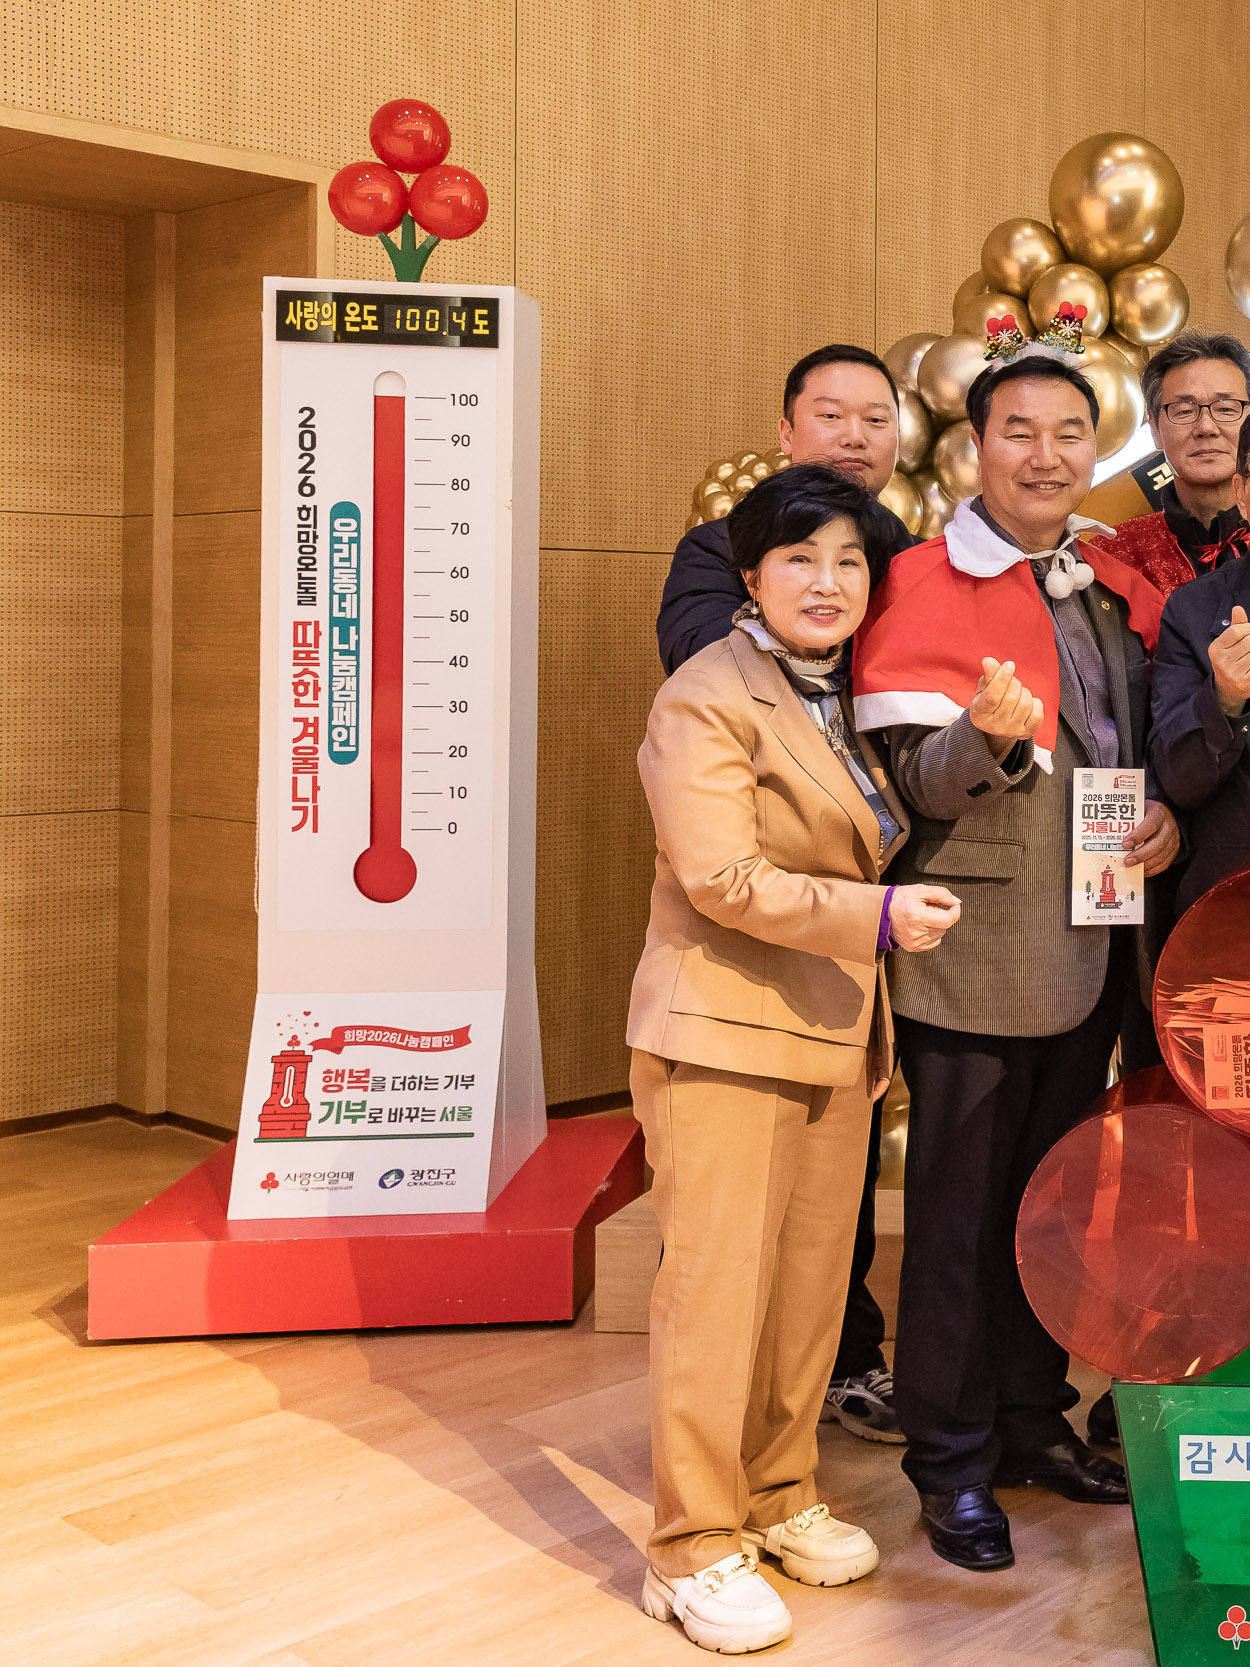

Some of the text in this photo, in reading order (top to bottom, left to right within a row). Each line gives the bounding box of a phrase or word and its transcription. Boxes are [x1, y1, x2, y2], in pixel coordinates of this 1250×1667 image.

[285, 300, 337, 332] 사랑의
[343, 301, 379, 332] 온도
[451, 394, 479, 407] 100
[451, 434, 471, 447] 90
[451, 478, 470, 491] 80
[450, 523, 470, 535] 70
[450, 566, 470, 579] 60
[291, 406, 322, 833] 2026 희망온돌 따뜻한 겨울나기
[449, 610, 469, 623] 50
[331, 517, 359, 752] 우리동네 나눔캠페인
[449, 655, 469, 668] 40
[448, 700, 468, 713] 30
[448, 745, 468, 758] 20
[449, 786, 468, 799] 10
[1082, 793, 1102, 802] 2026
[1081, 803, 1136, 820] 따뜻한
[447, 821, 458, 835] 0
[1081, 821, 1135, 834] 겨울나기
[321, 1068, 475, 1094] 행복을 더하는 기부
[1234, 1074, 1244, 1098] 2026
[318, 1099, 473, 1124] 기부로 바꾸는 서울
[409, 1168, 456, 1181] 광진구
